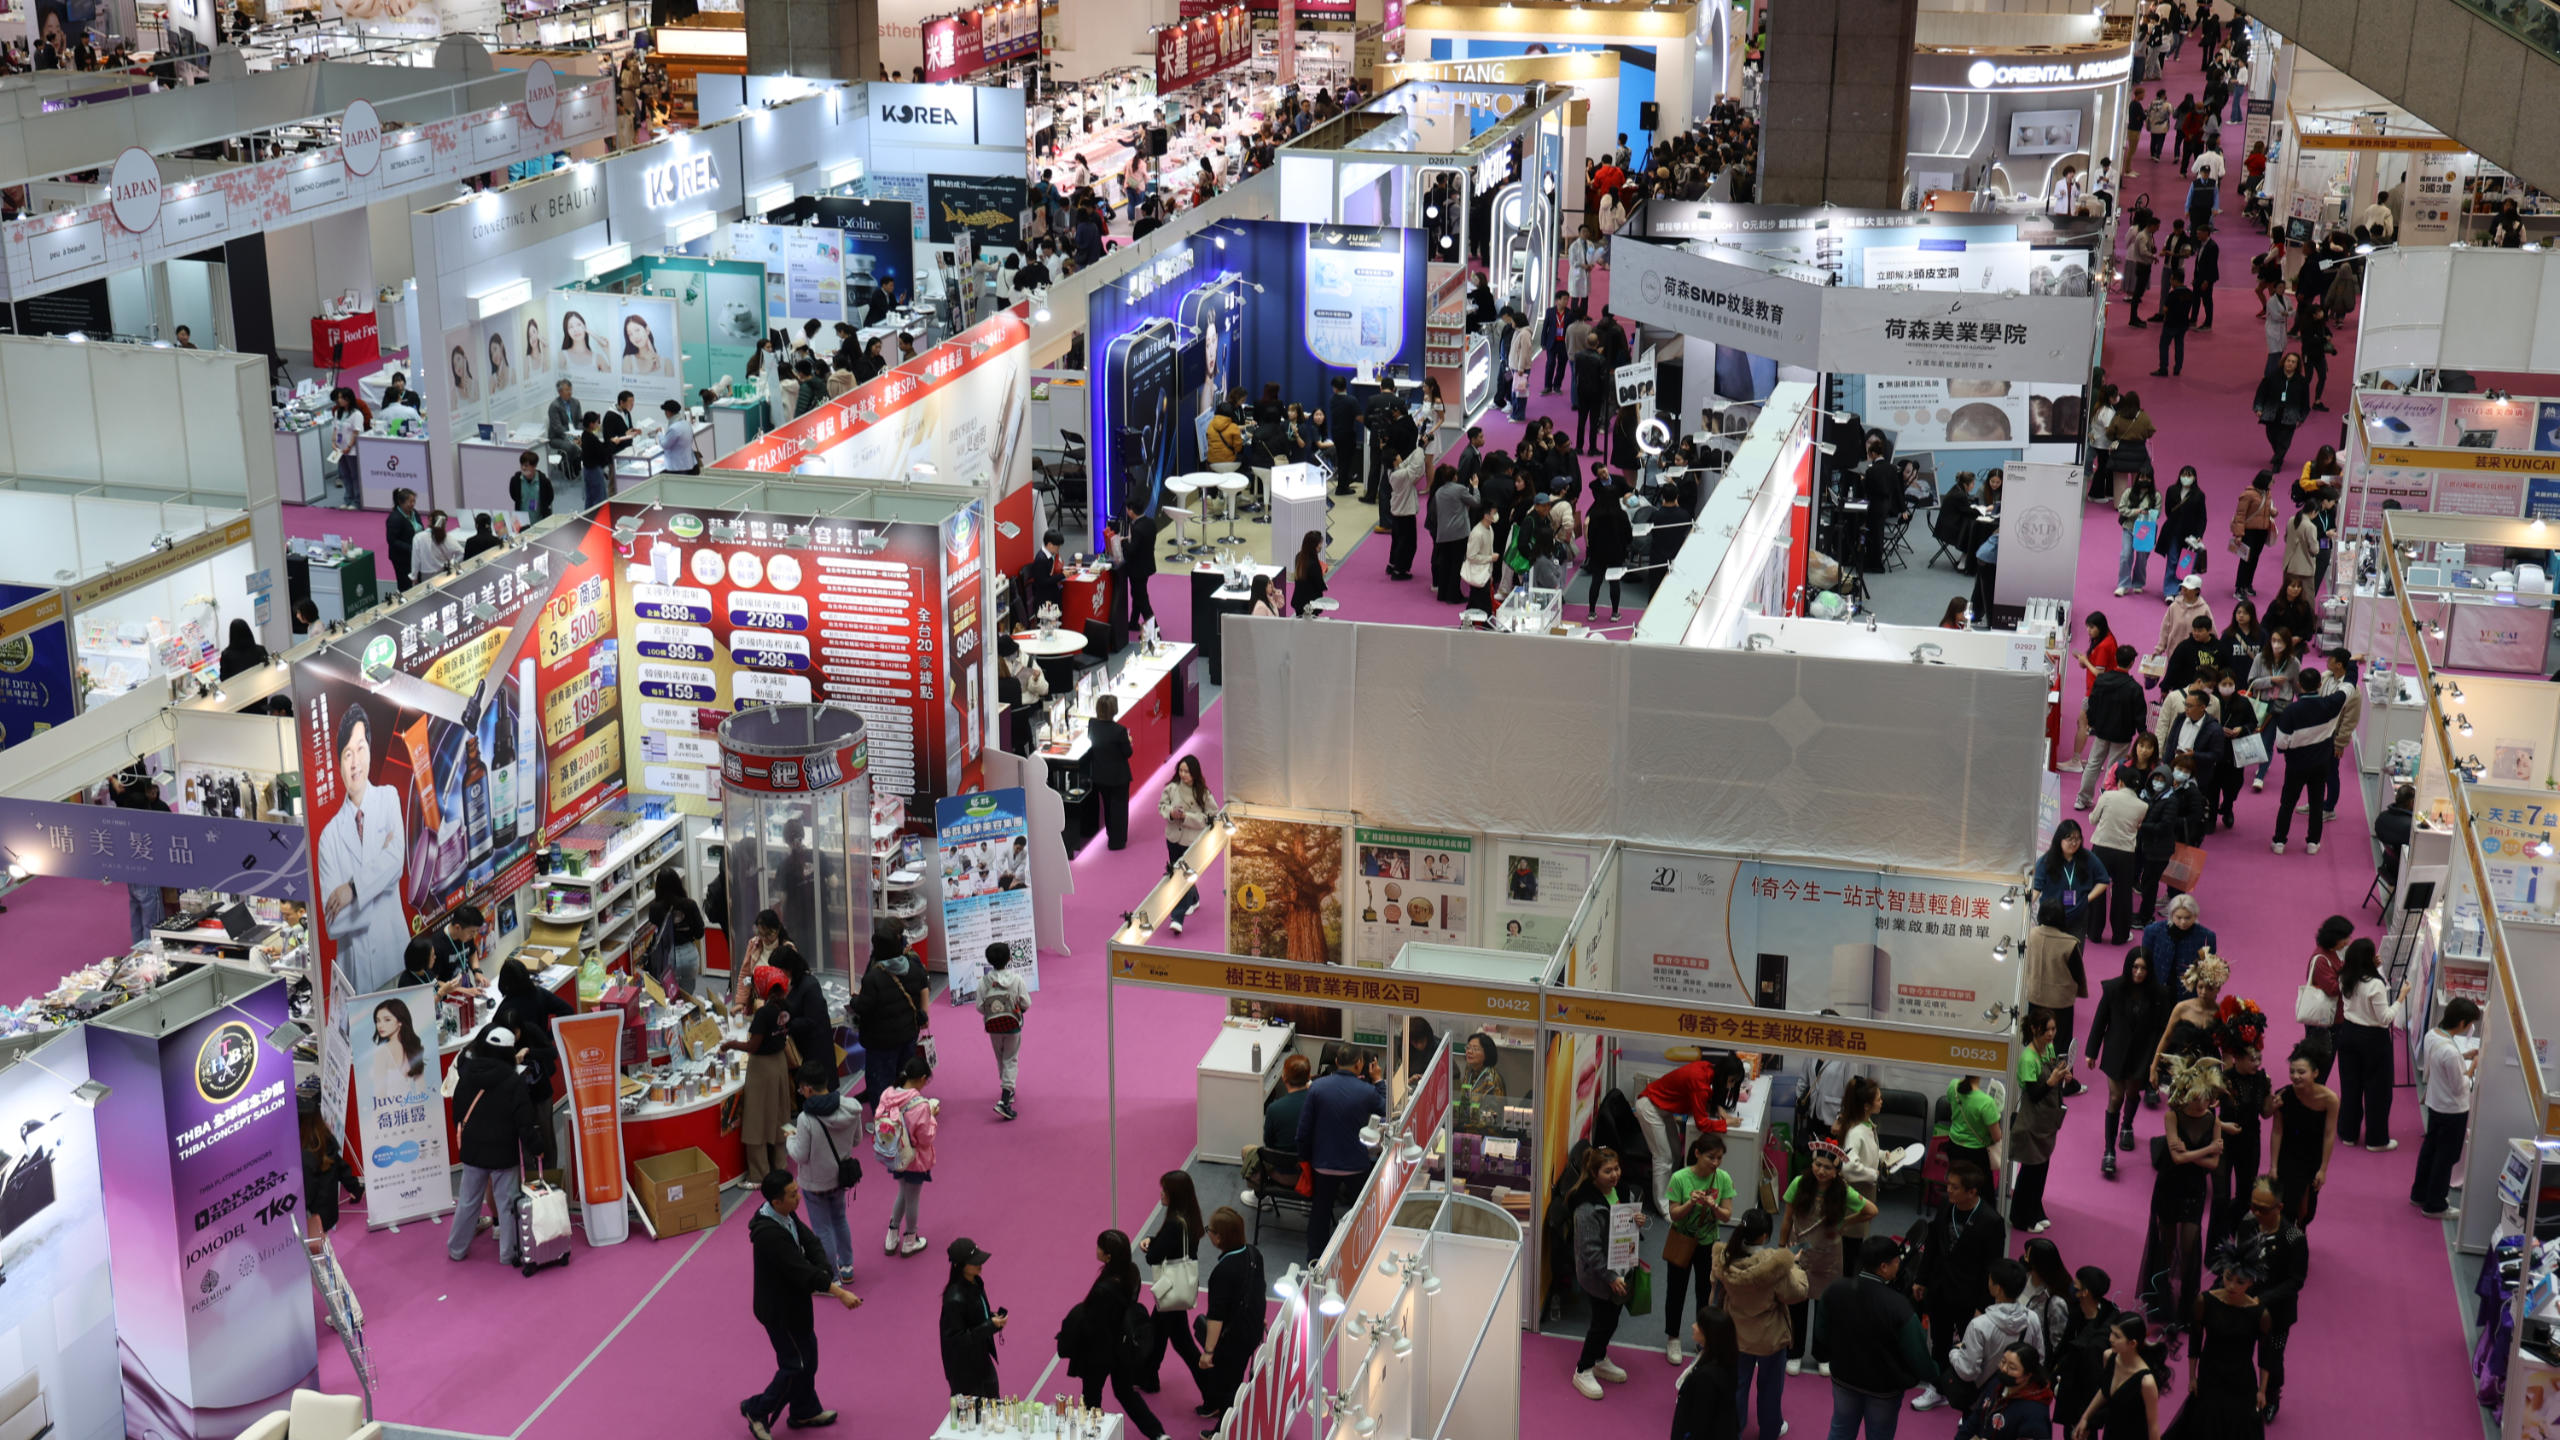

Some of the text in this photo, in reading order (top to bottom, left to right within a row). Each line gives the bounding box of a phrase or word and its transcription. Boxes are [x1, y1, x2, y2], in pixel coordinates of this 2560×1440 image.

[1454, 63, 1505, 83] TANG
[1995, 65, 2074, 84] ORIENTAL
[528, 85, 554, 103] JAPAN
[882, 105, 958, 125] KOREA
[346, 127, 378, 148] JAPAN
[1428, 157, 1454, 166] D2617
[116, 178, 157, 201] JAPAN
[645, 150, 721, 209] KOREA
[473, 212, 525, 239] CONNECTING
[550, 185, 598, 218] BEAUTY
[1877, 267, 1959, 280] 立即解決頭皮空洞
[1664, 275, 1784, 325] 荷森SMP紋髮教育
[1885, 318, 2027, 345] 荷森美業學院
[2504, 458, 2555, 471] YUNCAI
[2021, 521, 2056, 535] SMP
[546, 578, 601, 621] TOP商品
[747, 611, 793, 630] 2799元
[917, 607, 933, 700] 全台20家據點
[49, 825, 194, 865] 晴美髮品
[1875, 916, 1991, 939] 創業啟動超簡單
[1226, 967, 1420, 1005] 樹王生醫實業有限公司
[1487, 996, 1531, 1012] D0422
[1678, 1012, 1867, 1051] 傳奇今生美妝保養品
[1950, 1046, 1998, 1062] D0523
[176, 1121, 211, 1147] THBA
[178, 1097, 285, 1161] THBA CONCEPT SALON
[209, 1171, 278, 1213] TAKARA
[210, 1172, 288, 1224] BELMONT
[254, 1193, 298, 1226] TKO
[186, 1223, 247, 1269] JOMODEL
